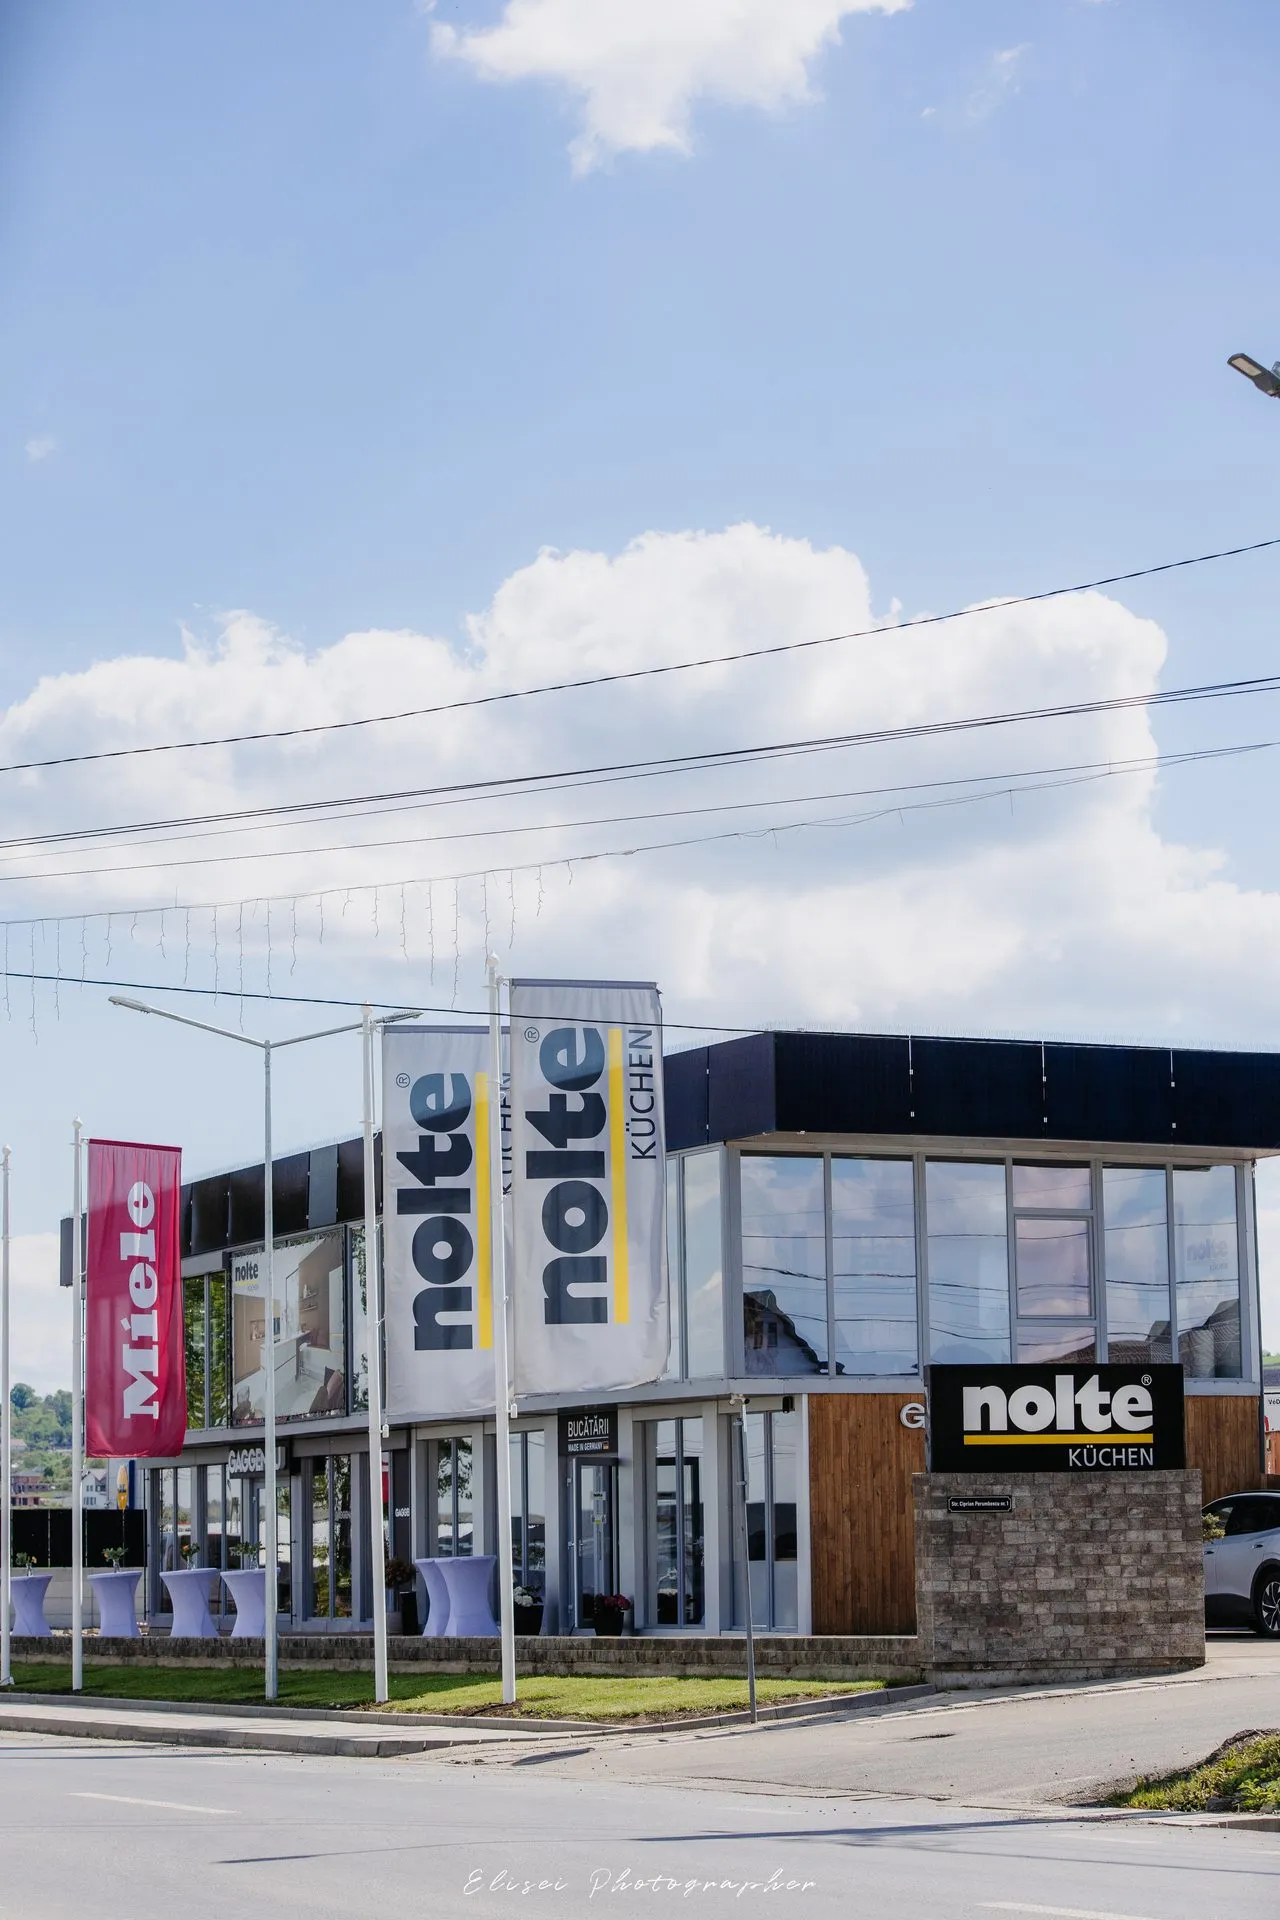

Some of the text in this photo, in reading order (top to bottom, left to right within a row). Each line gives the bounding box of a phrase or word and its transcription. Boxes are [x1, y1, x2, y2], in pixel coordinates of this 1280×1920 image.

[626, 1029, 657, 1160] KÜCHEN
[234, 1261, 259, 1282] nolte
[119, 1180, 159, 1420] Miele
[567, 1415, 609, 1437] BUCĂTĂRII
[228, 1446, 283, 1474] GAGGENU
[1068, 1445, 1154, 1467] KÜCHEN
